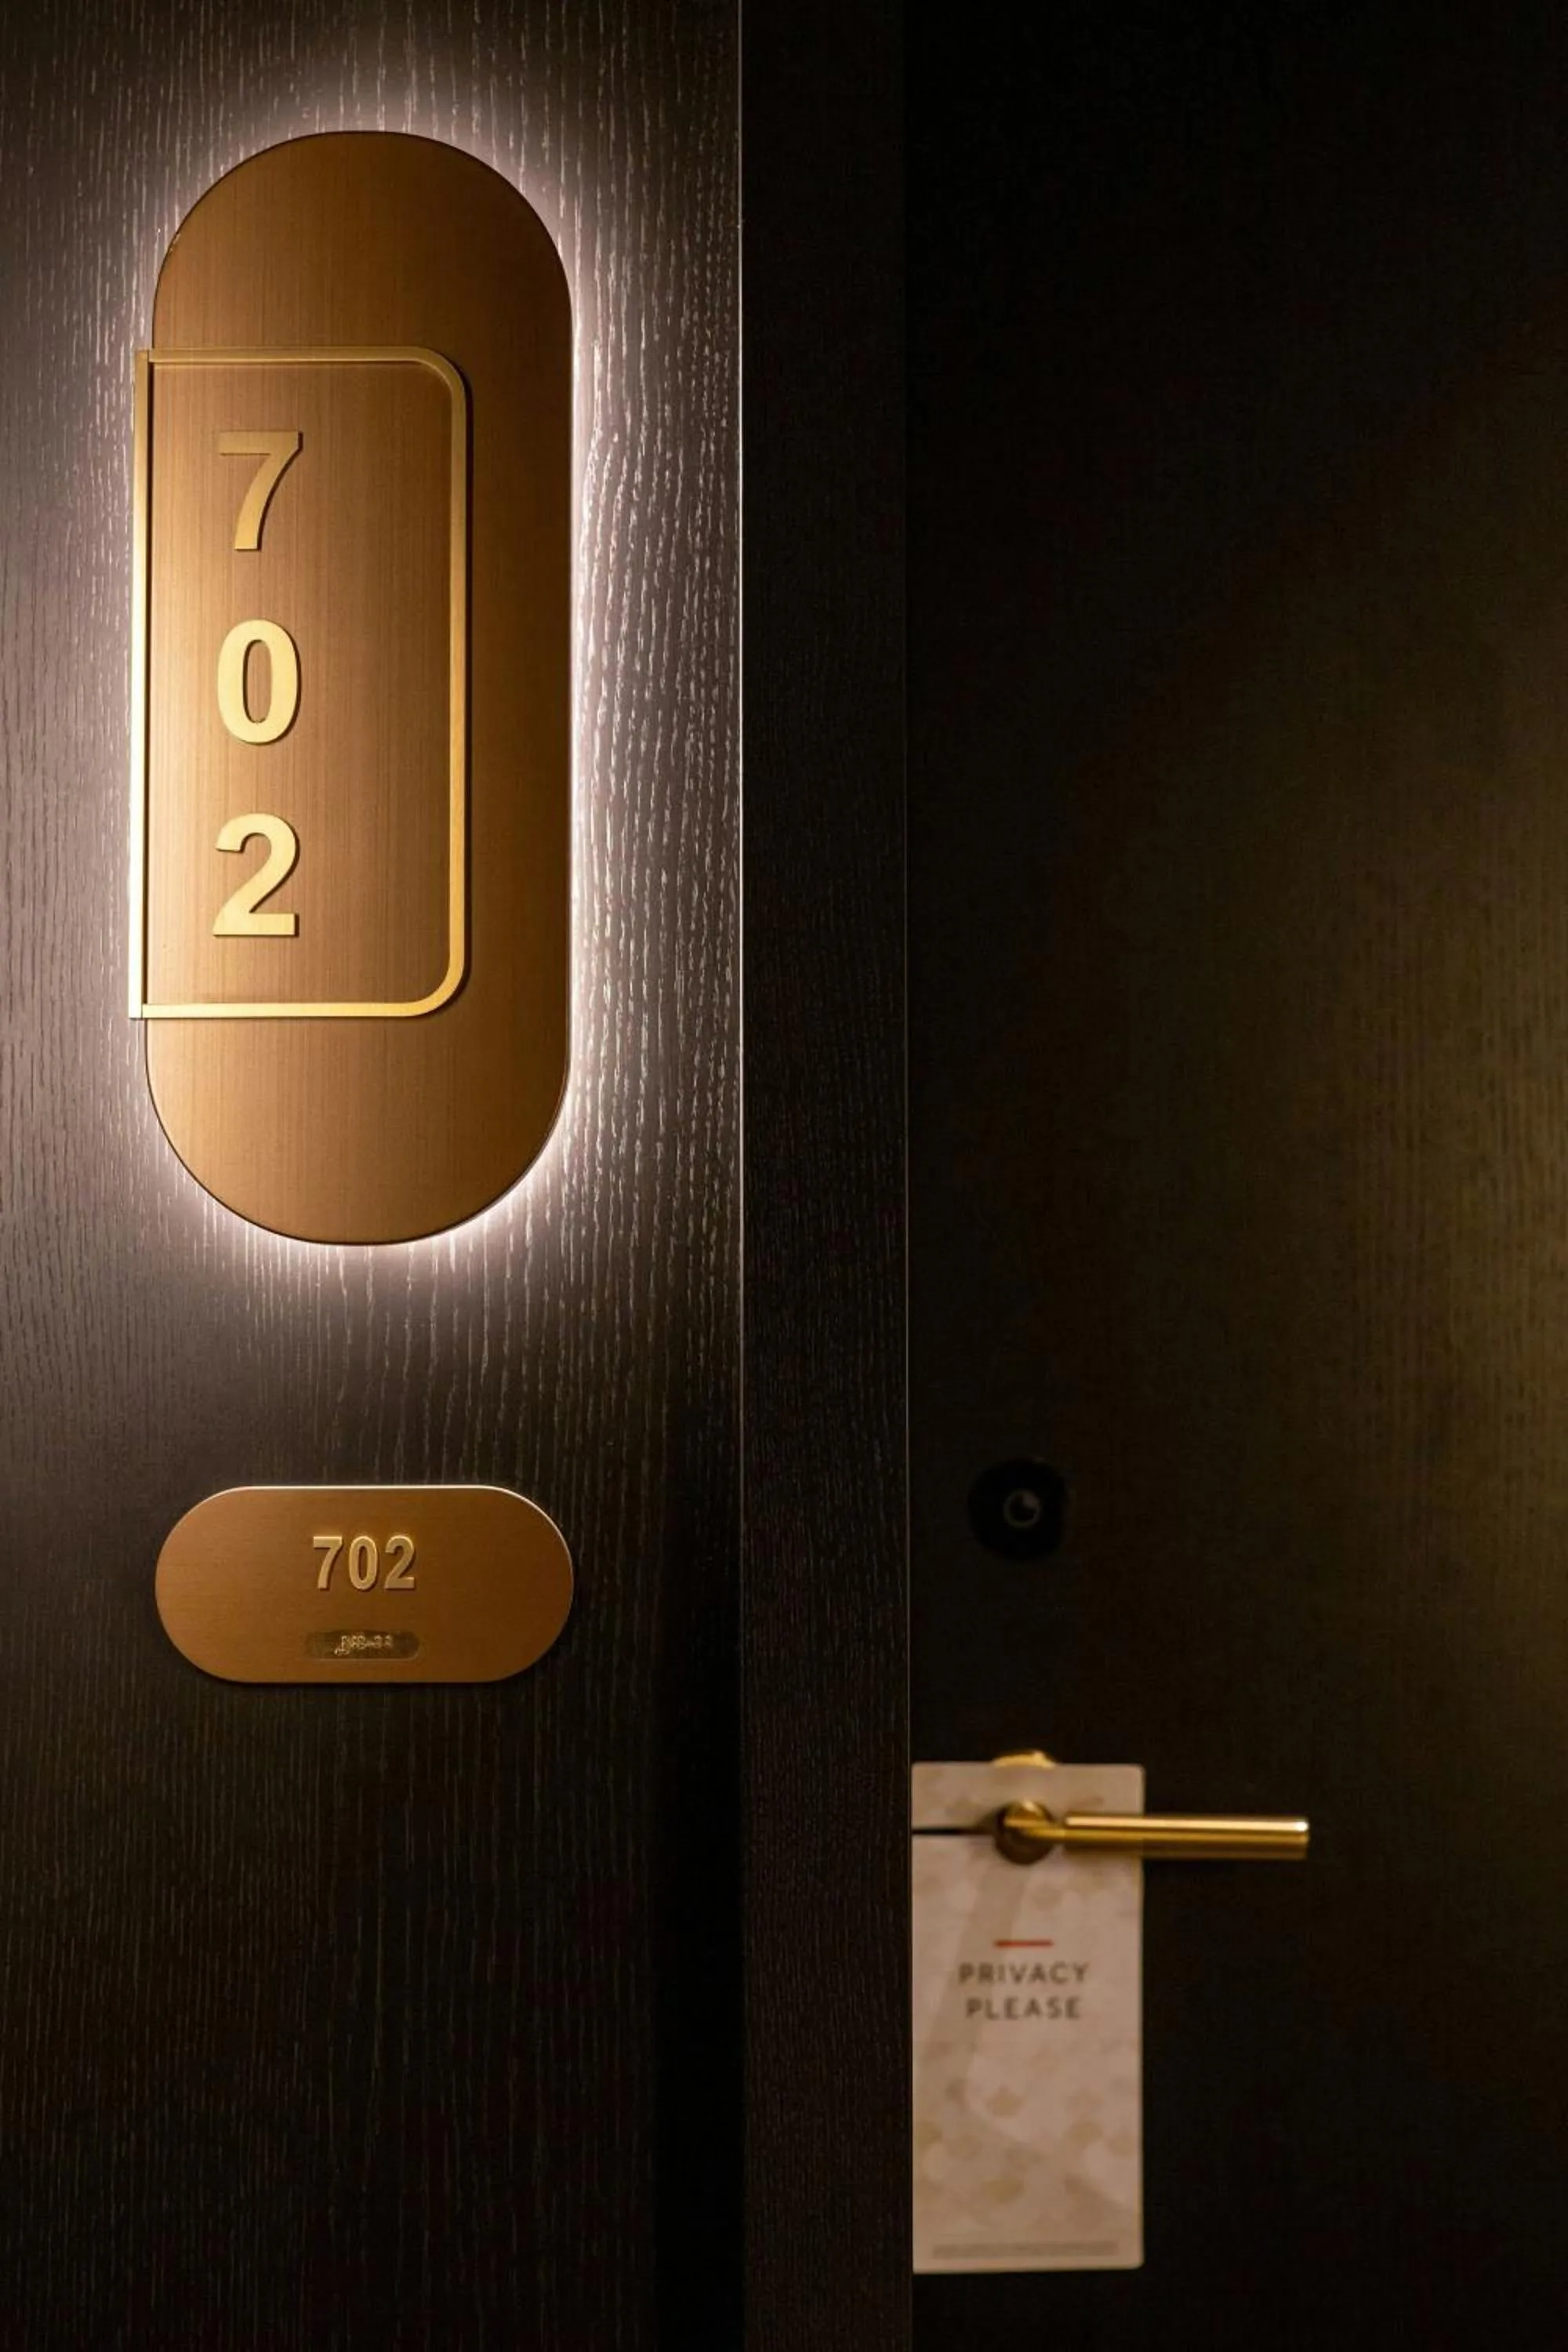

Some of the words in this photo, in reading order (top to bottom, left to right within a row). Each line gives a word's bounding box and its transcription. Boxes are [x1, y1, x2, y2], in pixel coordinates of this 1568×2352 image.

[313, 1535, 416, 1590] 702
[958, 1962, 1089, 1985] PRIVACY
[965, 1997, 1081, 2020] PLEASE
